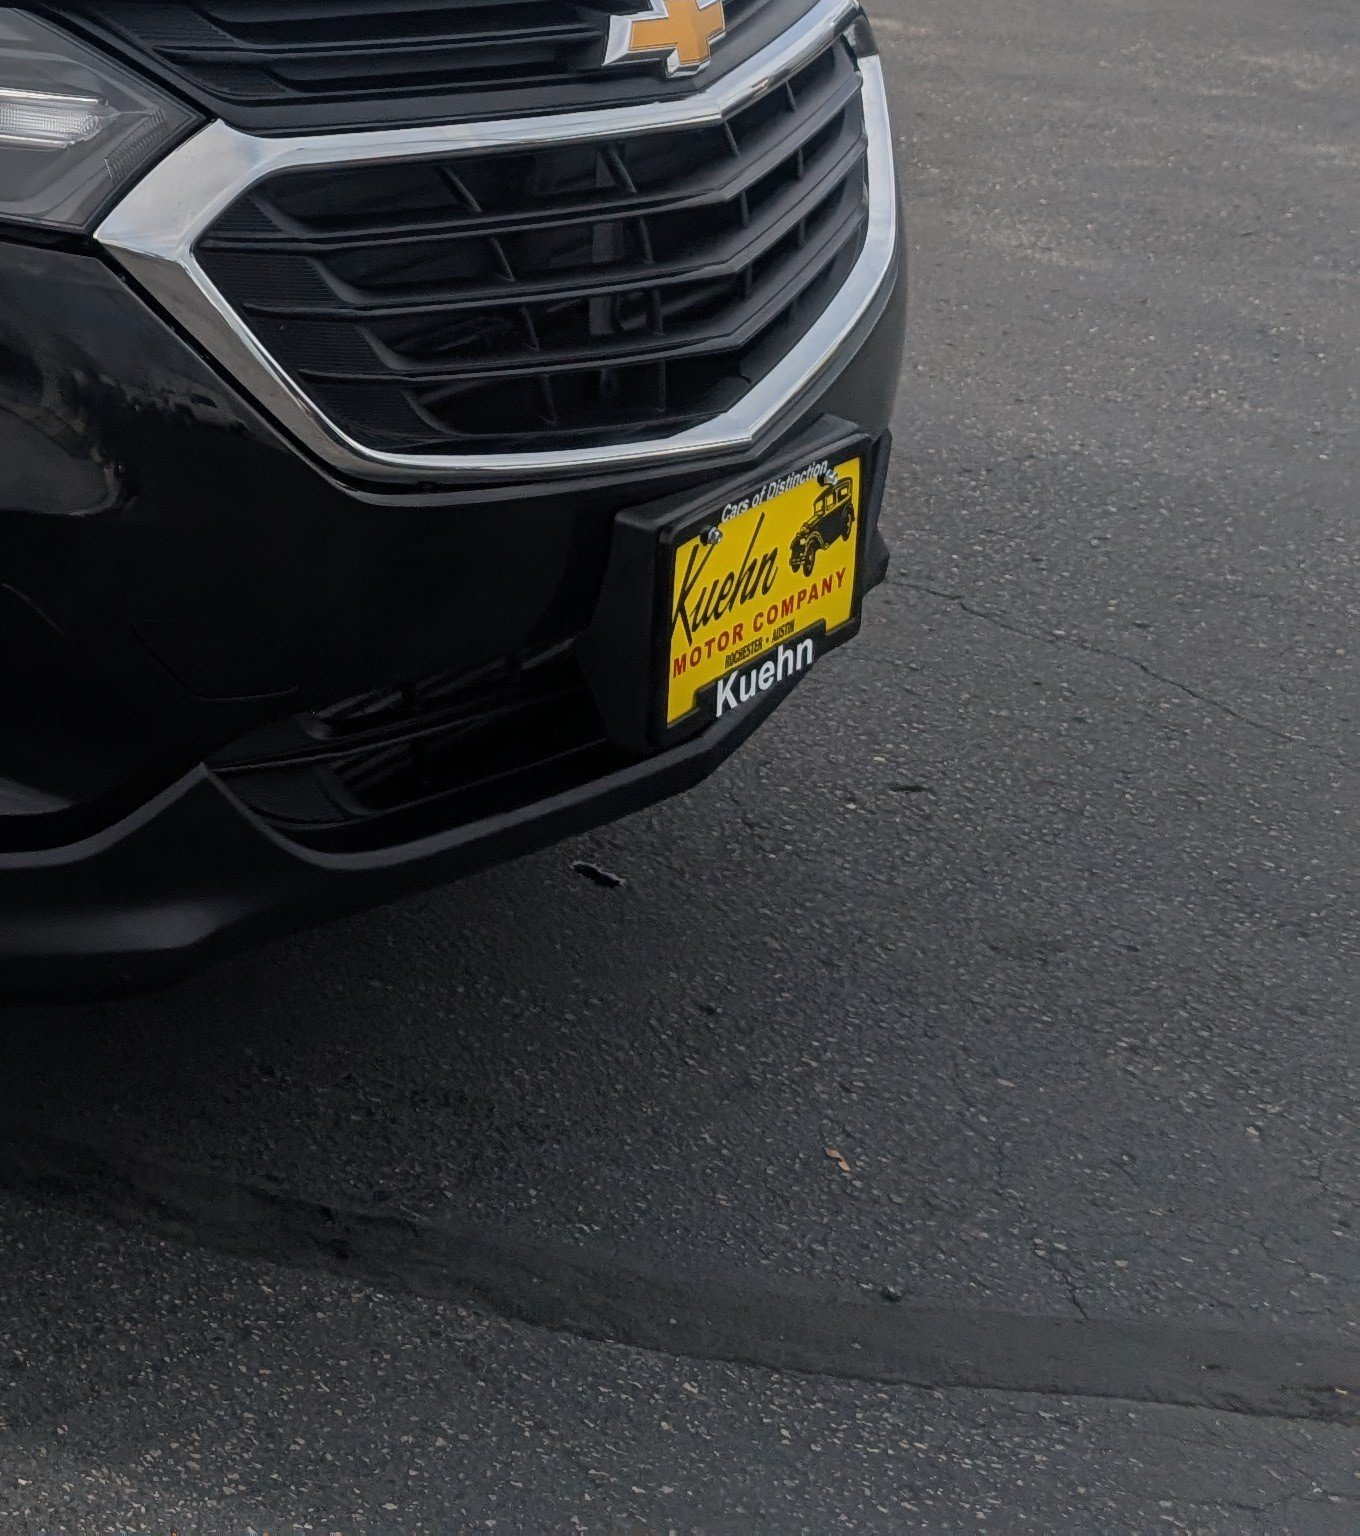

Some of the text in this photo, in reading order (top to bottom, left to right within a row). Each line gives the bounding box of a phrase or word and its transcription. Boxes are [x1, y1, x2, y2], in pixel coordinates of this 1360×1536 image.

[721, 460, 828, 522] Cars of Distinction
[671, 512, 779, 647] Kuehn
[673, 567, 846, 678] MOTOR COMPANY
[716, 638, 813, 717] Kuehn
